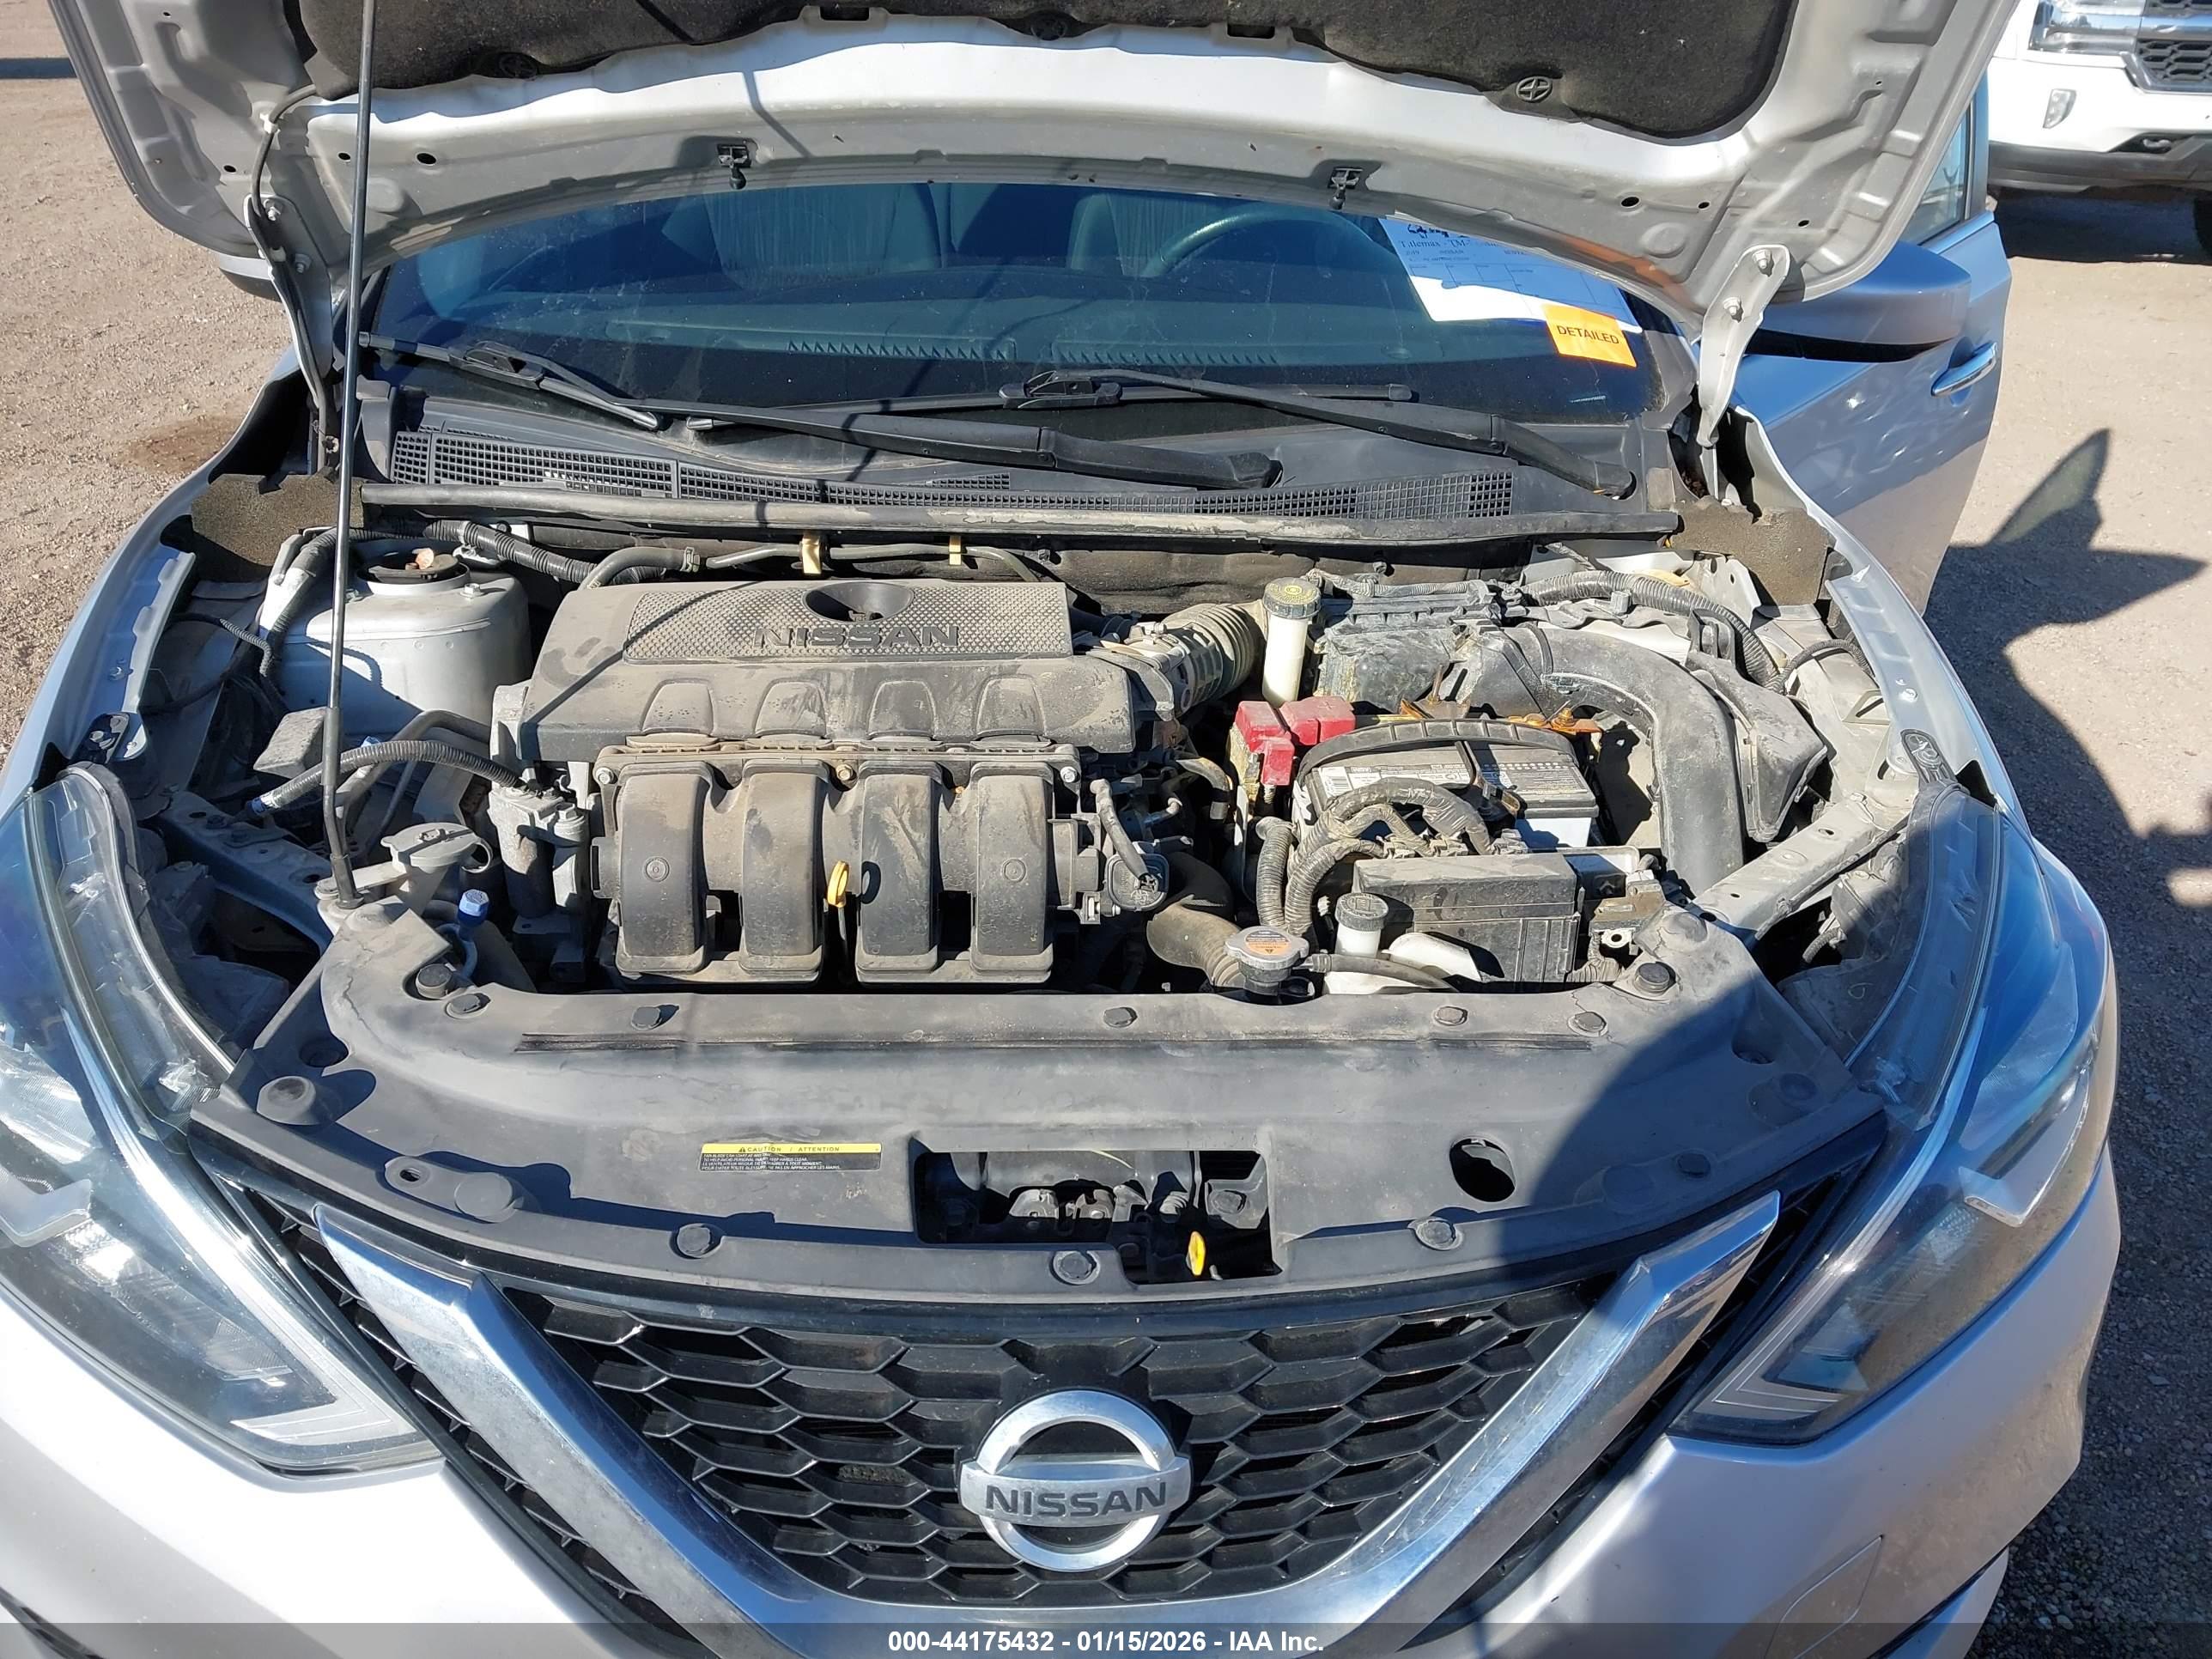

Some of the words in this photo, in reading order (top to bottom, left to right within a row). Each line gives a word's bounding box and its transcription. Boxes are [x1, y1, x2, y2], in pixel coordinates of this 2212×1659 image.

[1556, 325, 1620, 344] DETAILED
[753, 625, 960, 647] NISSAN
[987, 1482, 1166, 1516] NISSAN
